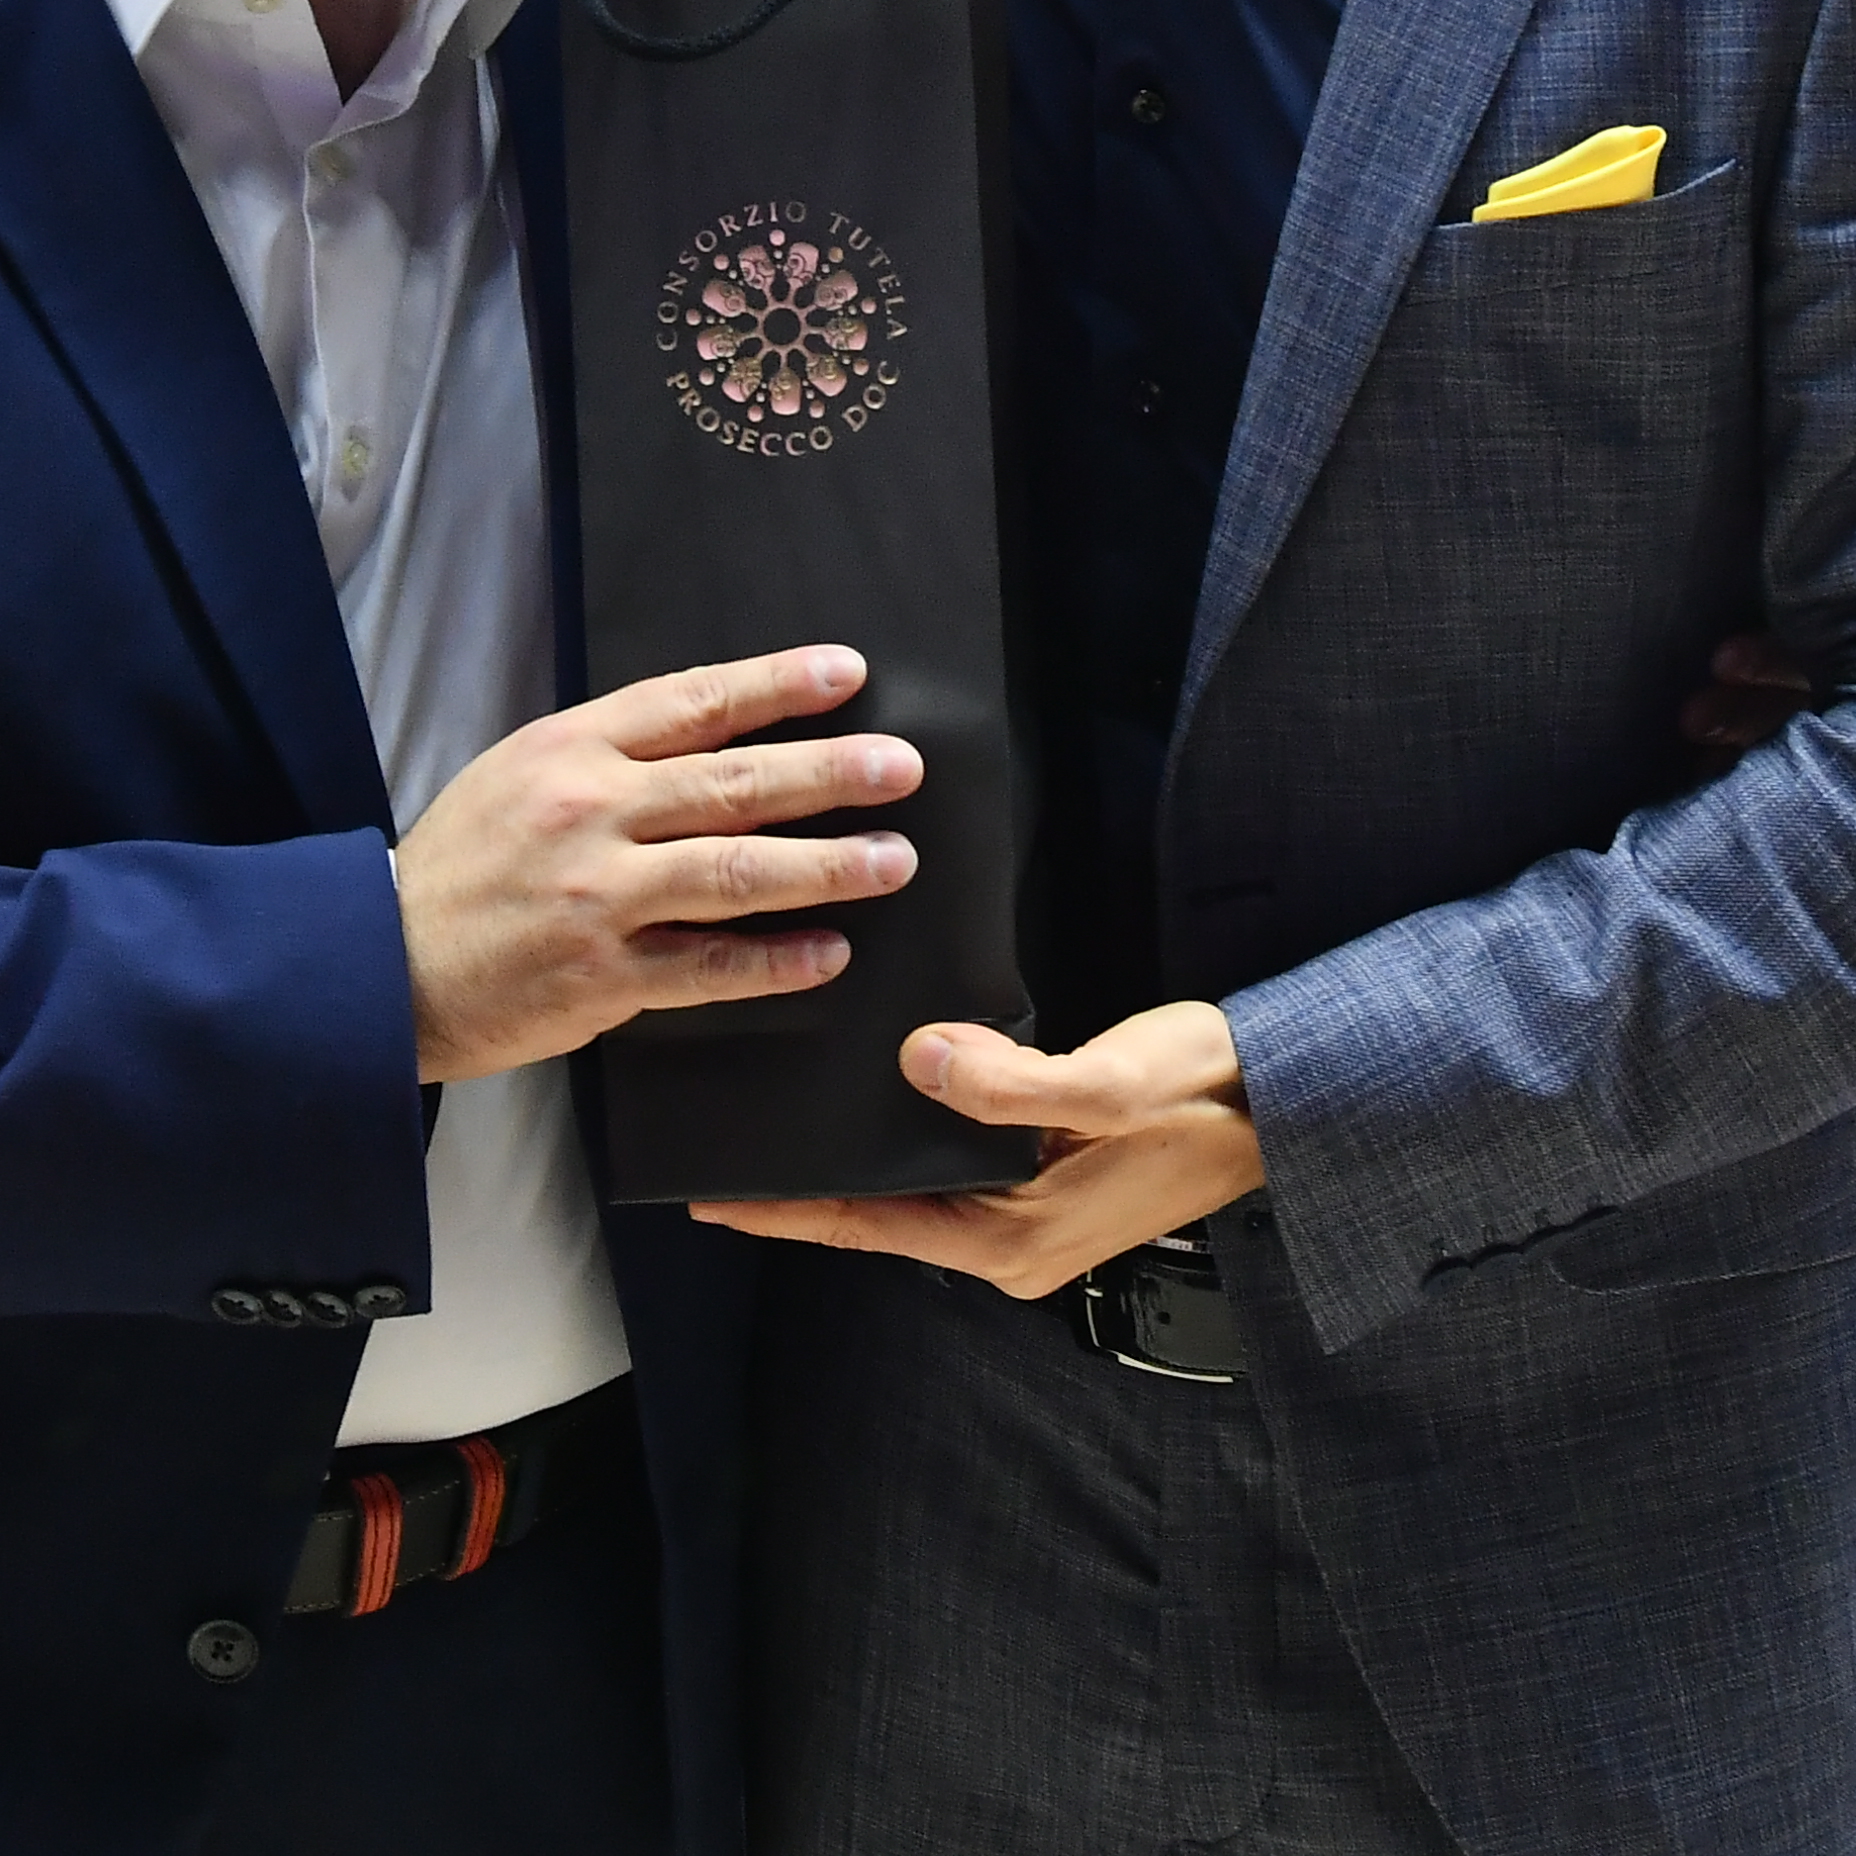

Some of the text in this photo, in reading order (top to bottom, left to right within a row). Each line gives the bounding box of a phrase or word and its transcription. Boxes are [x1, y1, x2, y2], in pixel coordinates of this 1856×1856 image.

[656, 200, 908, 352] CONSORZIO TUTELA
[665, 360, 901, 457] PROSECCO DOC
